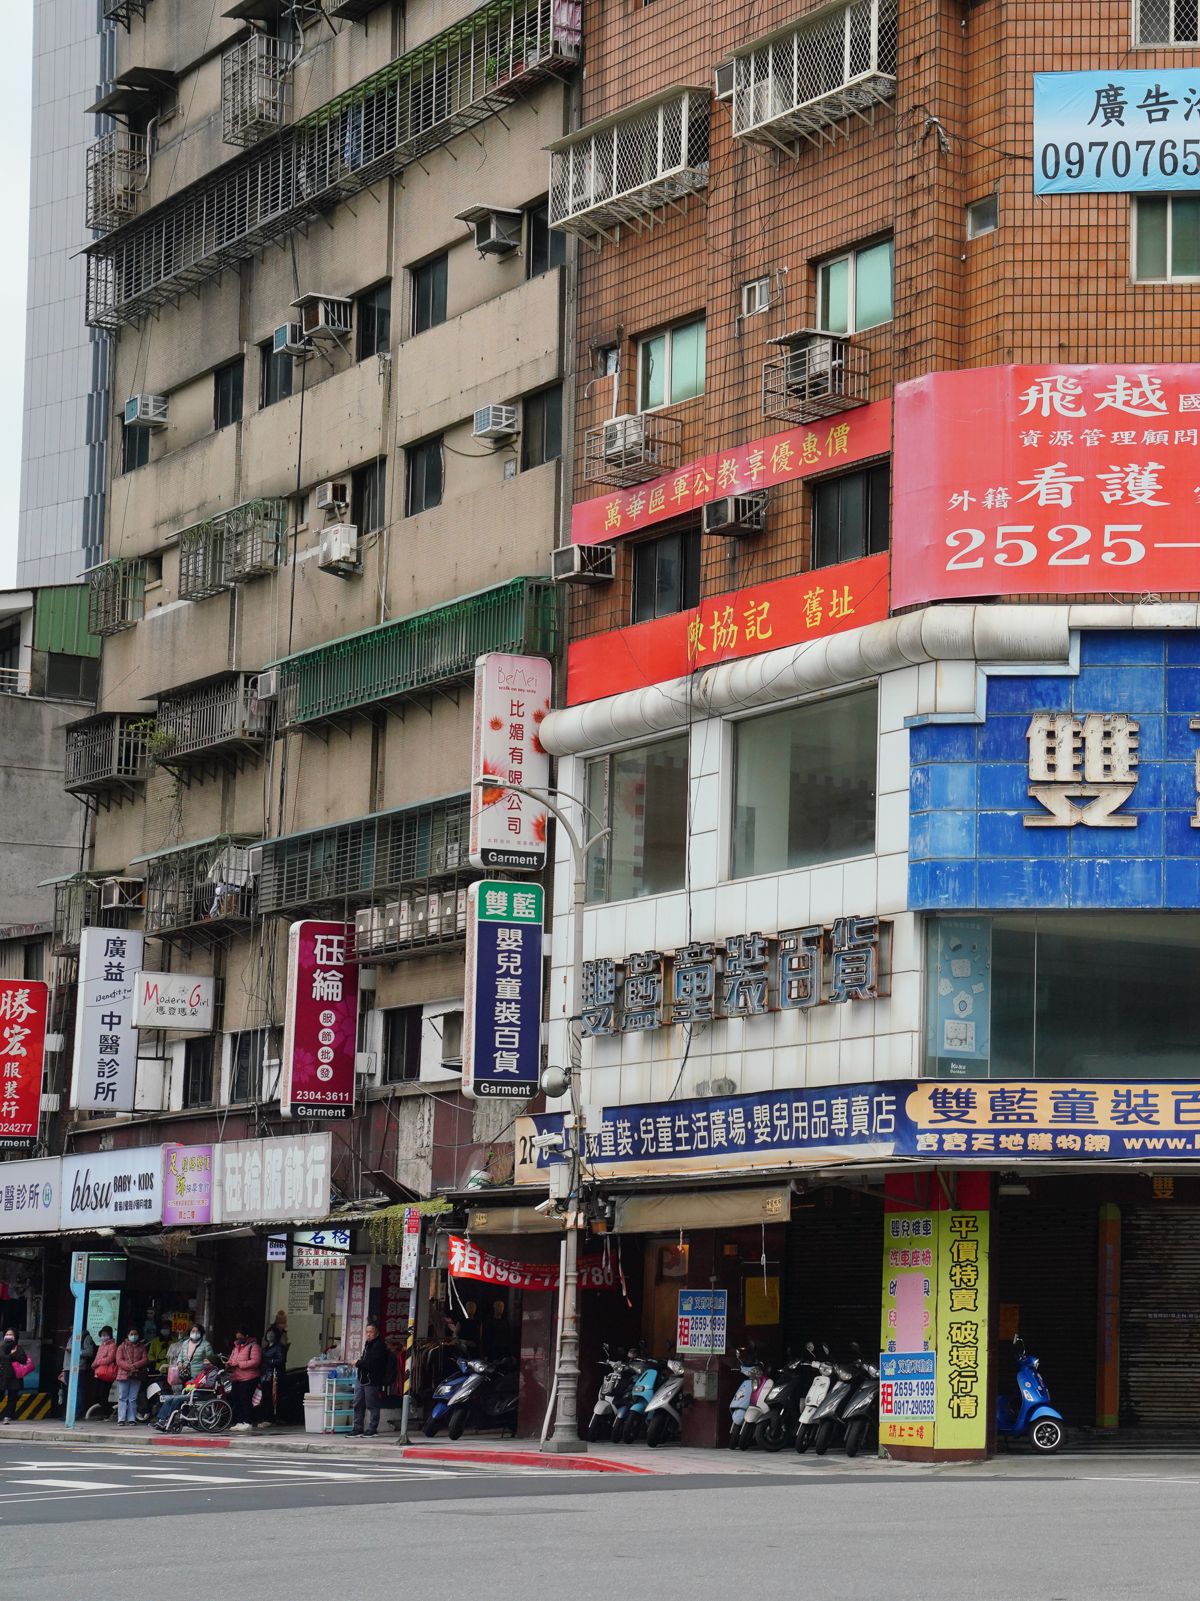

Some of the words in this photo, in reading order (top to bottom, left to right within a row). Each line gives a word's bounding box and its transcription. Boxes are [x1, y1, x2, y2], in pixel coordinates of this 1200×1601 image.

[604, 422, 851, 531] 萬華區軍公教享優惠價
[946, 462, 1172, 512] 外籍看護
[687, 600, 773, 661] 陳協記
[802, 585, 856, 629] 舊址
[507, 699, 525, 835] 比媚有限公司
[488, 852, 538, 866] Garment
[485, 890, 536, 918] 雙藍
[104, 936, 127, 981] 廣益
[143, 981, 186, 1006] Modern
[188, 984, 209, 1008] Girl
[493, 928, 523, 1074] 嬰兒童裝百貨
[94, 1011, 122, 1102] 中醫診所
[296, 1090, 349, 1101] 2304-3611
[480, 1082, 531, 1095] Garment
[297, 1106, 346, 1118] Garment
[916, 1133, 1111, 1153] 寶寶天地購物網
[113, 1175, 131, 1192] BABY
[138, 1172, 154, 1190] KIDS
[450, 1240, 482, 1276] 租
[949, 1215, 979, 1312] 平價特賣
[679, 1318, 690, 1346] 租
[690, 1333, 725, 1348] 0917-29558
[949, 1321, 979, 1419] 破壞行情
[881, 1383, 893, 1414] 租
[894, 1381, 935, 1397] 2659-1999
[894, 1400, 935, 1415] 0917-290558
